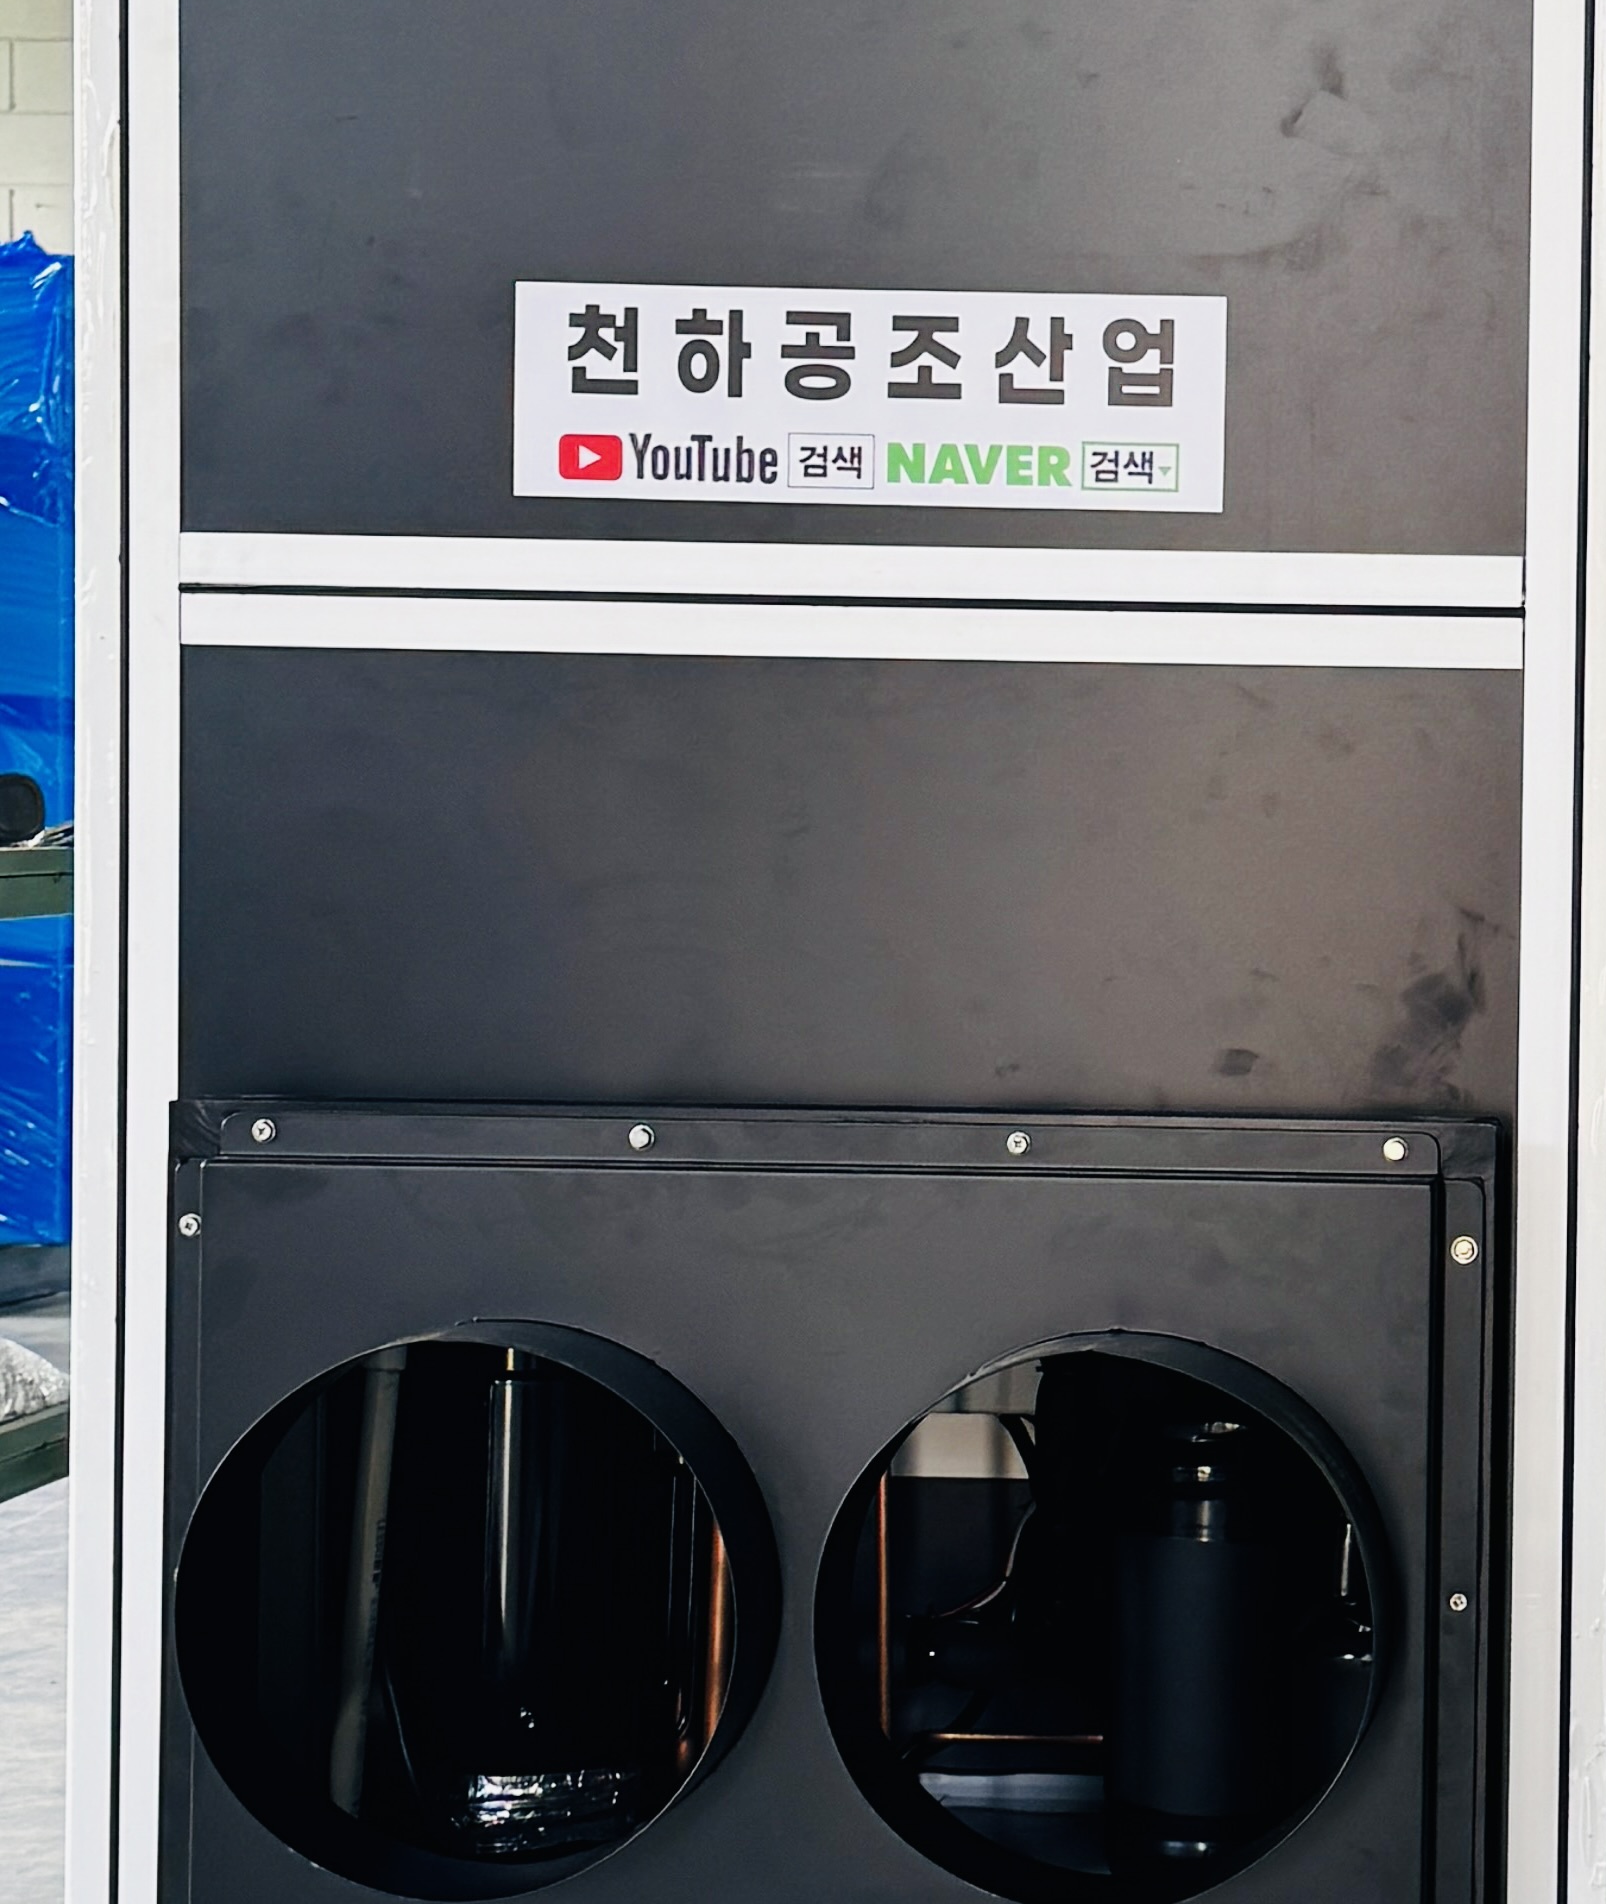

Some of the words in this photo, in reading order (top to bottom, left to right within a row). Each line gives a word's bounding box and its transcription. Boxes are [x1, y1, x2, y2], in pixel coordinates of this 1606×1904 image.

[567, 304, 1175, 407] 천하공조산업
[629, 433, 778, 485] YouTube
[799, 445, 863, 480] 검색
[886, 442, 1072, 487] NAVER
[1090, 450, 1154, 485] 검색
